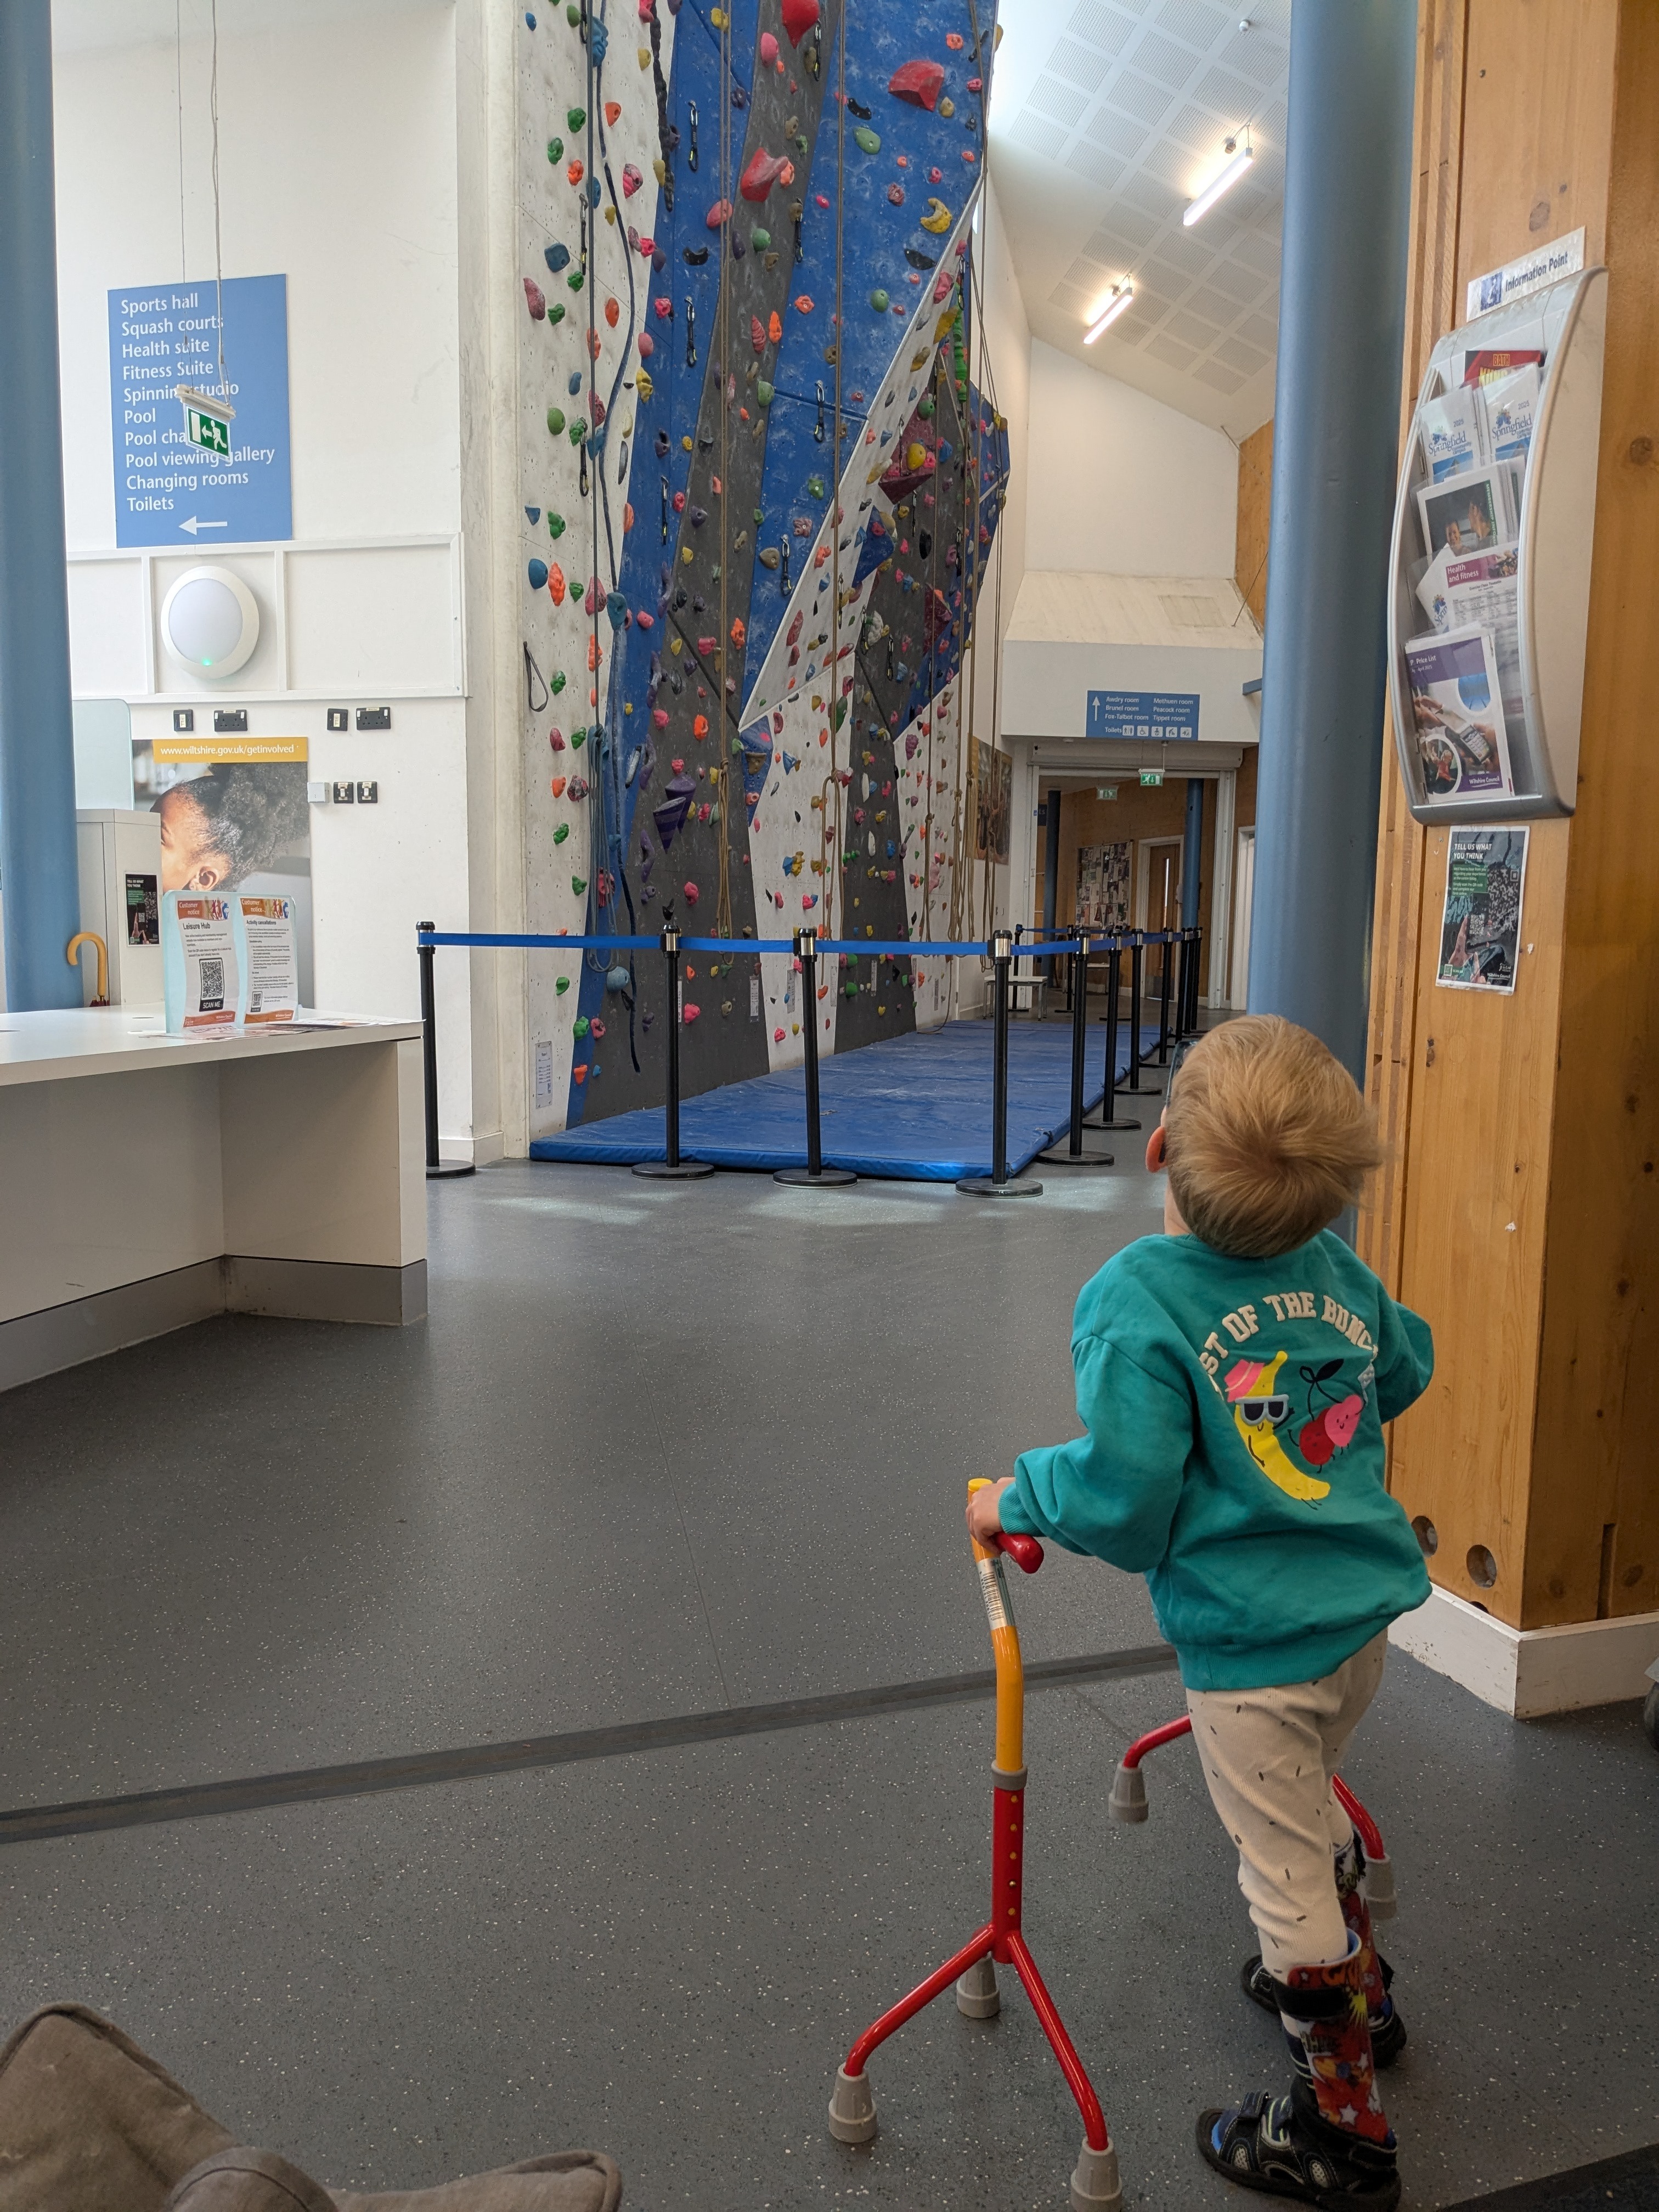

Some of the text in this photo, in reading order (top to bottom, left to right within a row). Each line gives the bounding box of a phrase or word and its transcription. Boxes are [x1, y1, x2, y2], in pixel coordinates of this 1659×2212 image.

[1505, 251, 1568, 292] Information Point
[121, 292, 198, 318] Sports hall
[122, 315, 224, 340] Squash courts
[122, 338, 210, 358] Health suite
[123, 360, 213, 380] Fitness Suite
[1493, 354, 1510, 366] BATH
[124, 385, 177, 406] Spinnin
[125, 408, 156, 424] Pool
[1453, 418, 1464, 427] 2025
[1492, 413, 1532, 441] Springfield
[125, 430, 156, 446] Pool
[1429, 431, 1466, 456] Springfield
[126, 452, 157, 468] Pool
[162, 450, 219, 467] viewing
[126, 472, 249, 492] Changing rooms
[127, 496, 174, 511] Toilets
[1447, 564, 1466, 574] Health
[1448, 570, 1479, 583] and fitness
[161, 744, 294, 757] www.wiltshire.gov.uk/getinvolved
[1199, 1291, 1378, 1388] ST OF THE BUNC
